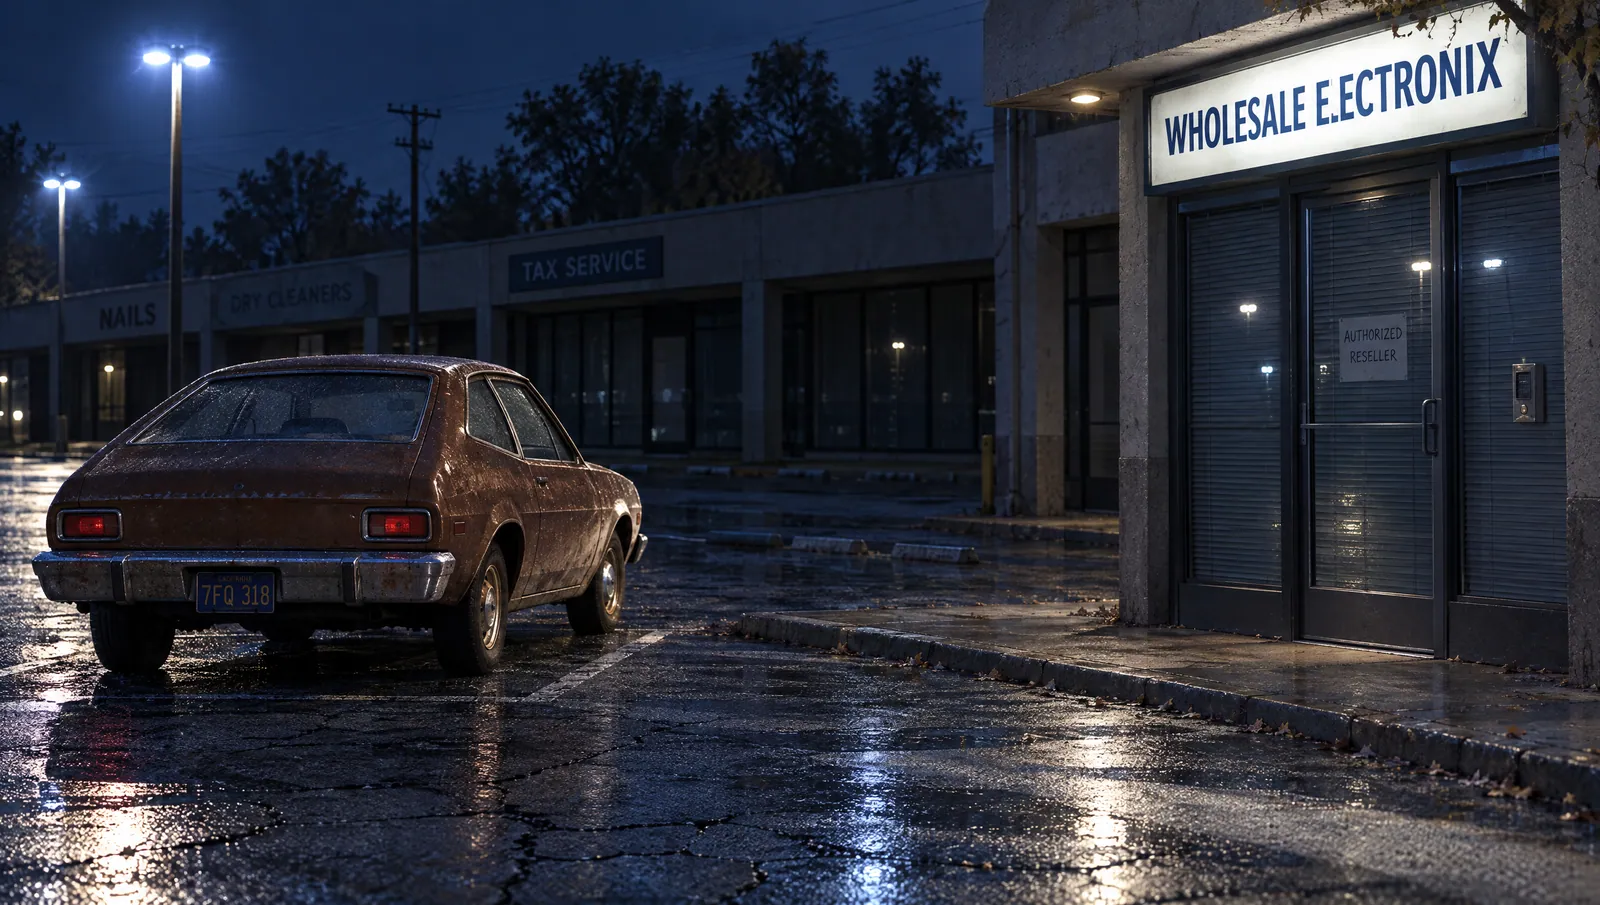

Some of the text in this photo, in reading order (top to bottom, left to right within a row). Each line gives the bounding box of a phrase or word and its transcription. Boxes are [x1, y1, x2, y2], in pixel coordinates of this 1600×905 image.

[1165, 37, 1503, 156] WHOLESALE EECTRONIX
[522, 249, 647, 282] TAX SERVICE
[231, 281, 352, 314] DRY CLEANERS
[99, 302, 156, 330] NAILS
[1344, 327, 1403, 343] AUTHORIZED
[1350, 349, 1398, 364] RESELLER
[201, 584, 270, 606] 7FQ 318
